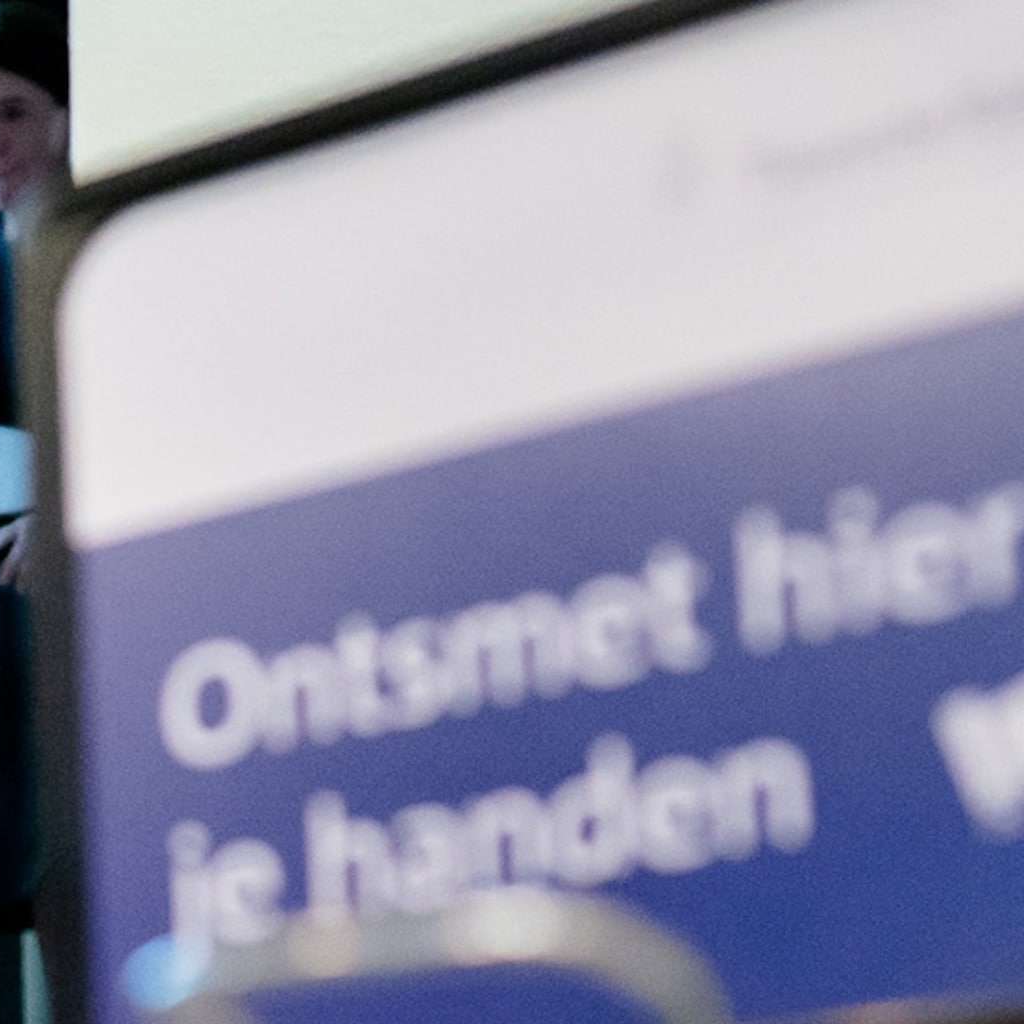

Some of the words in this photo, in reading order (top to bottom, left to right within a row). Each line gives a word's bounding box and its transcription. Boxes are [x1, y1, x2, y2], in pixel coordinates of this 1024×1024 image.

[163, 543, 710, 767] Ontsmet
[735, 485, 1024, 652] hier
[169, 820, 286, 968] je
[305, 734, 814, 912] handen
